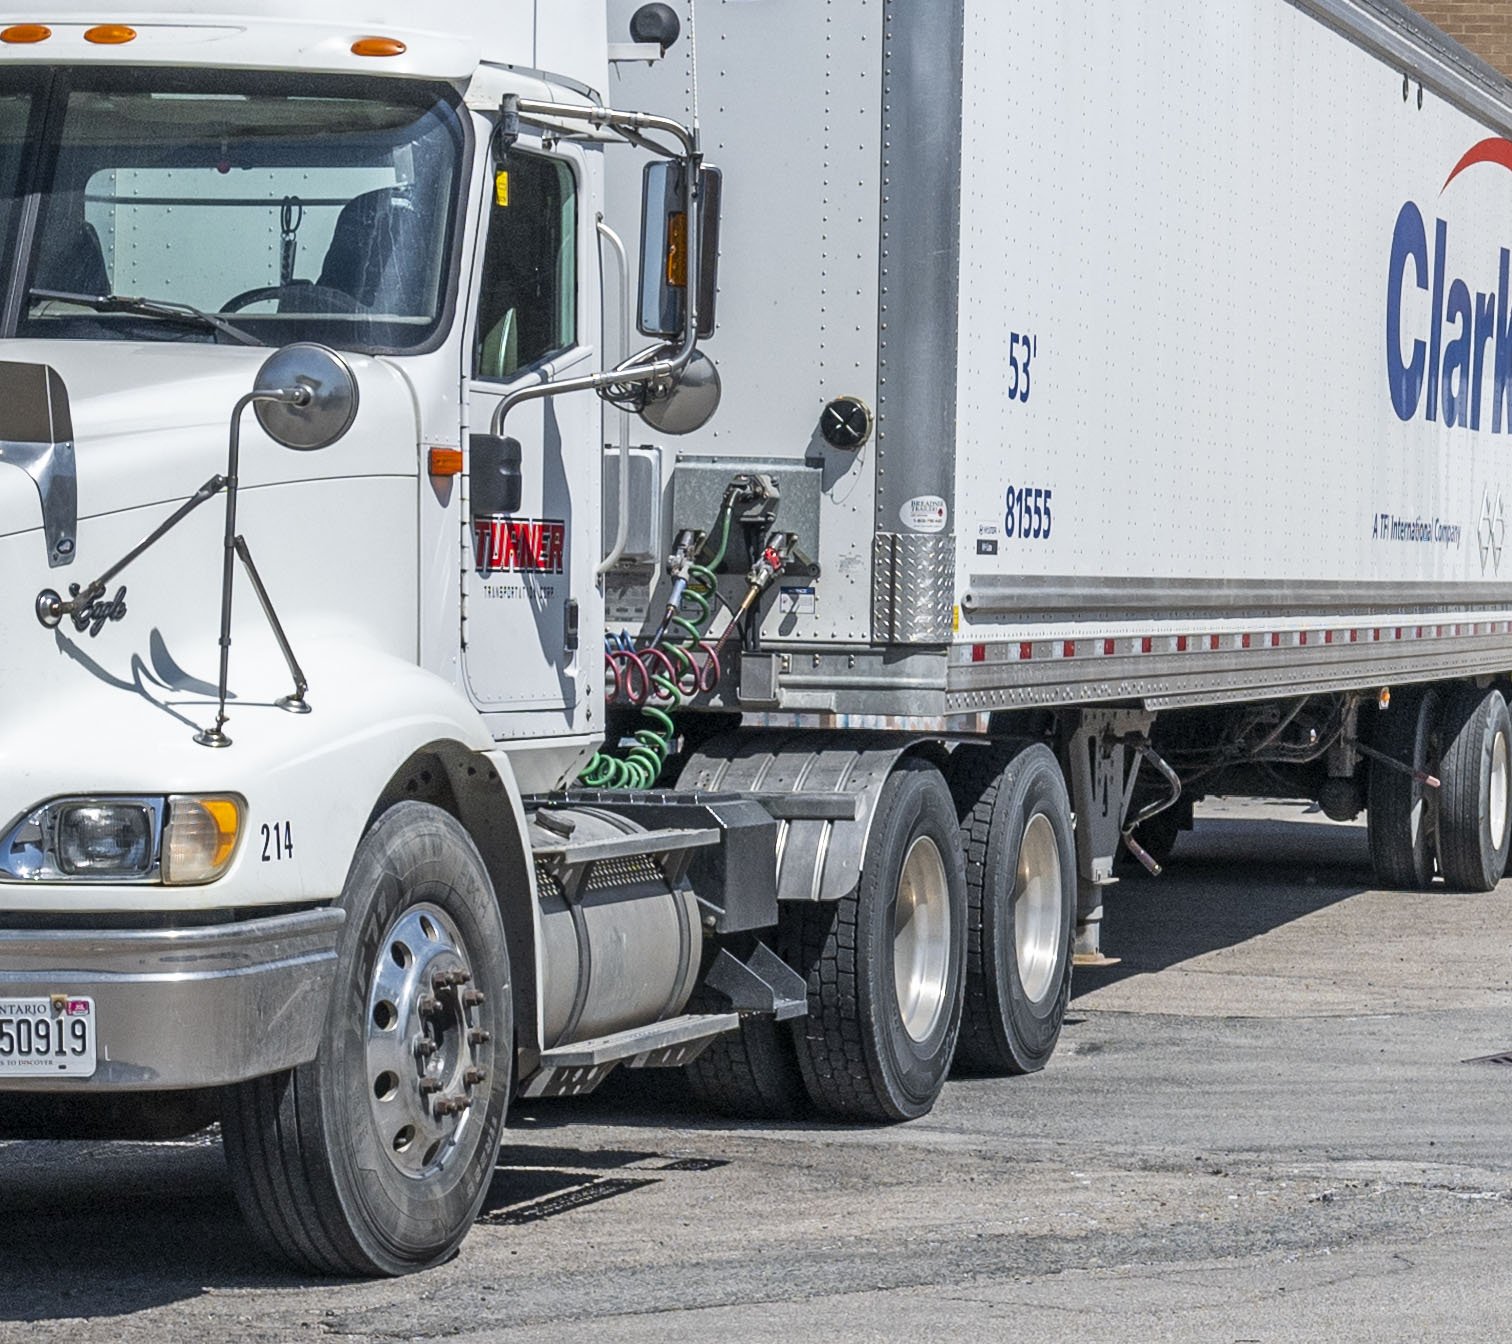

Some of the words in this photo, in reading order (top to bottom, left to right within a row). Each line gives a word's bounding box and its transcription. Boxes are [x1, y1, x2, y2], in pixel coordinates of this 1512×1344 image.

[1008, 331, 1037, 403] 53'
[1005, 485, 1052, 539] 81555
[1390, 515, 1434, 543] International
[1434, 517, 1462, 550] Company
[475, 515, 564, 574] TURNER
[261, 821, 293, 861] 214
